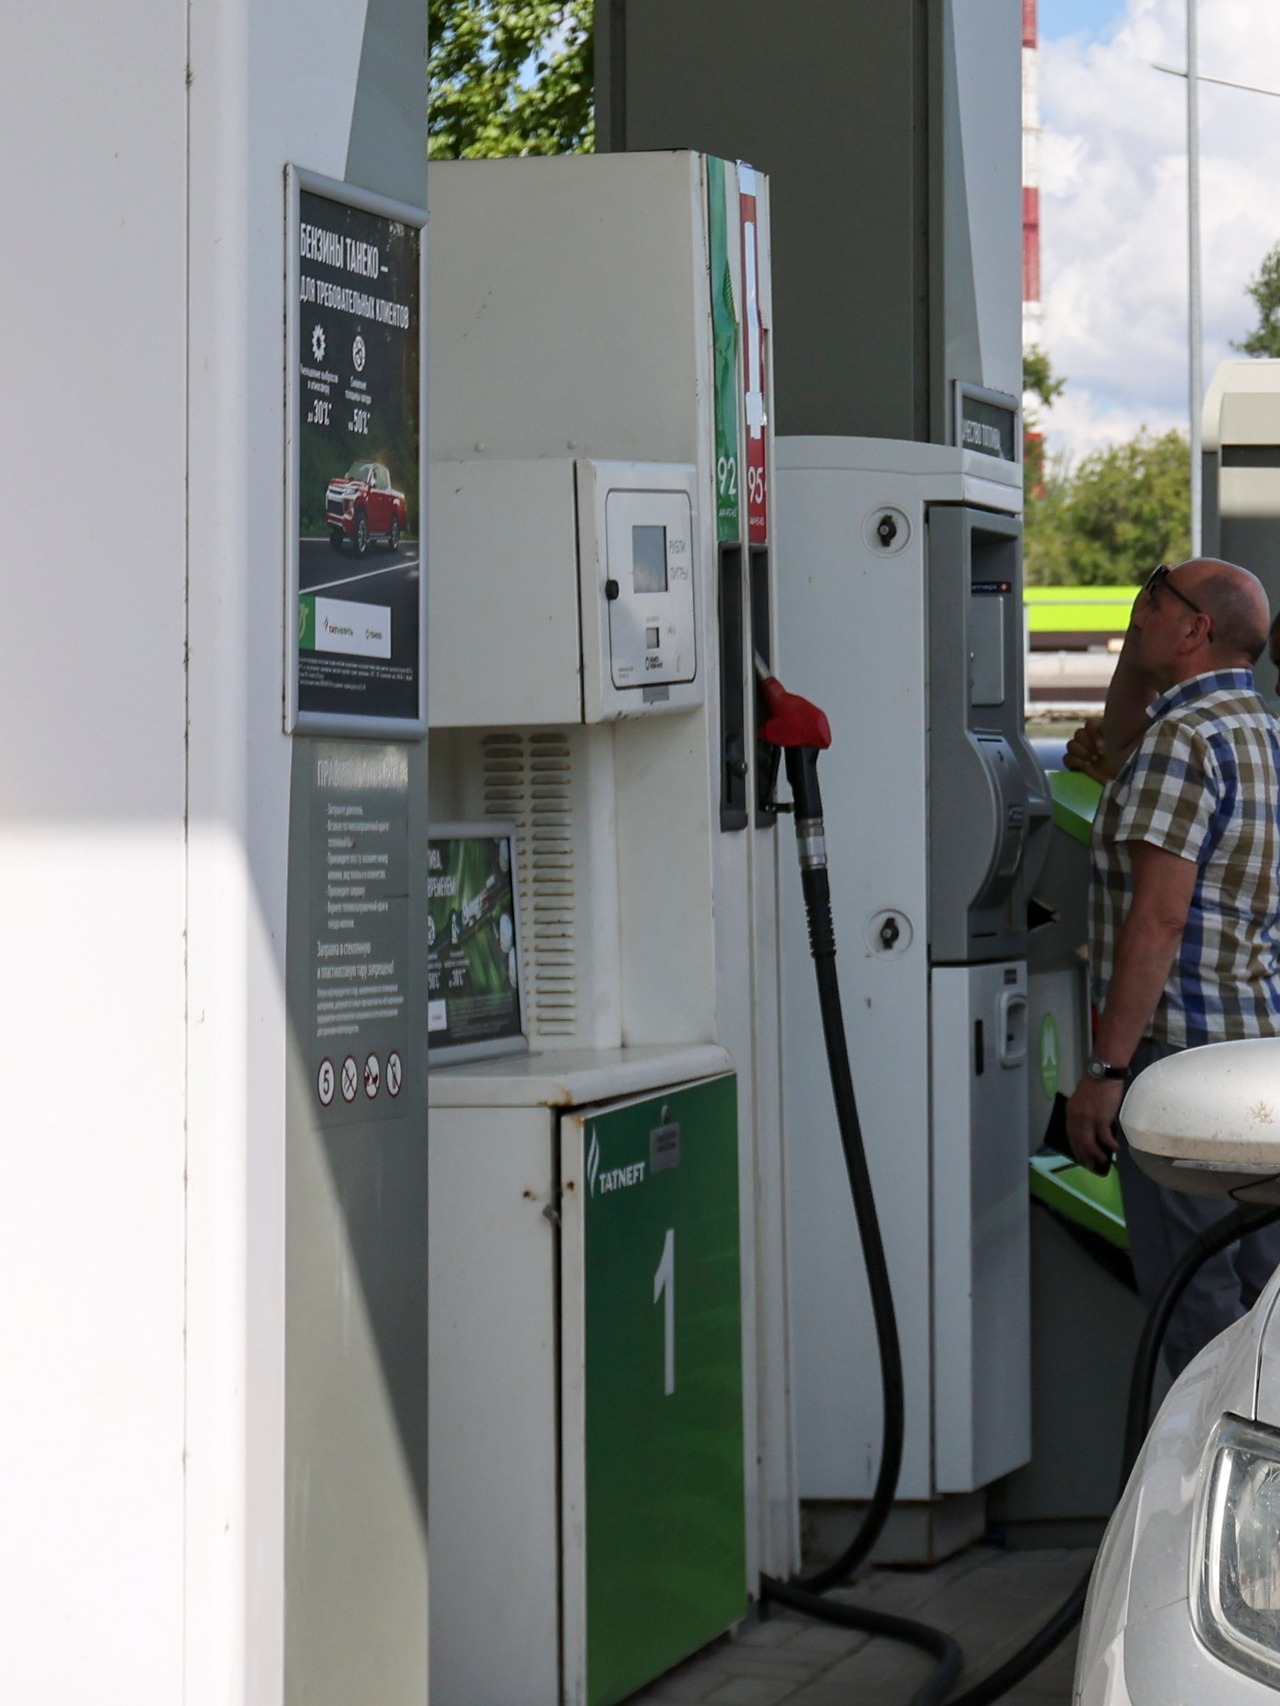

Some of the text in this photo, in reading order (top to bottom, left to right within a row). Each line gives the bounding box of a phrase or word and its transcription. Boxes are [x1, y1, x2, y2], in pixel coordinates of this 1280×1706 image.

[300, 222, 344, 269] БЕНЗИНЫ
[345, 238, 379, 279] ТАНЕКО
[300, 275, 410, 330] ДЛЯ ТРЕБОВАТЕЛЬНЫХ КЛИЕНТОВ
[717, 456, 737, 495] 92
[748, 465, 764, 504] 95
[323, 1069, 329, 1095] 5
[598, 1161, 646, 1194] TATNEFT
[653, 1227, 675, 1397] 1
